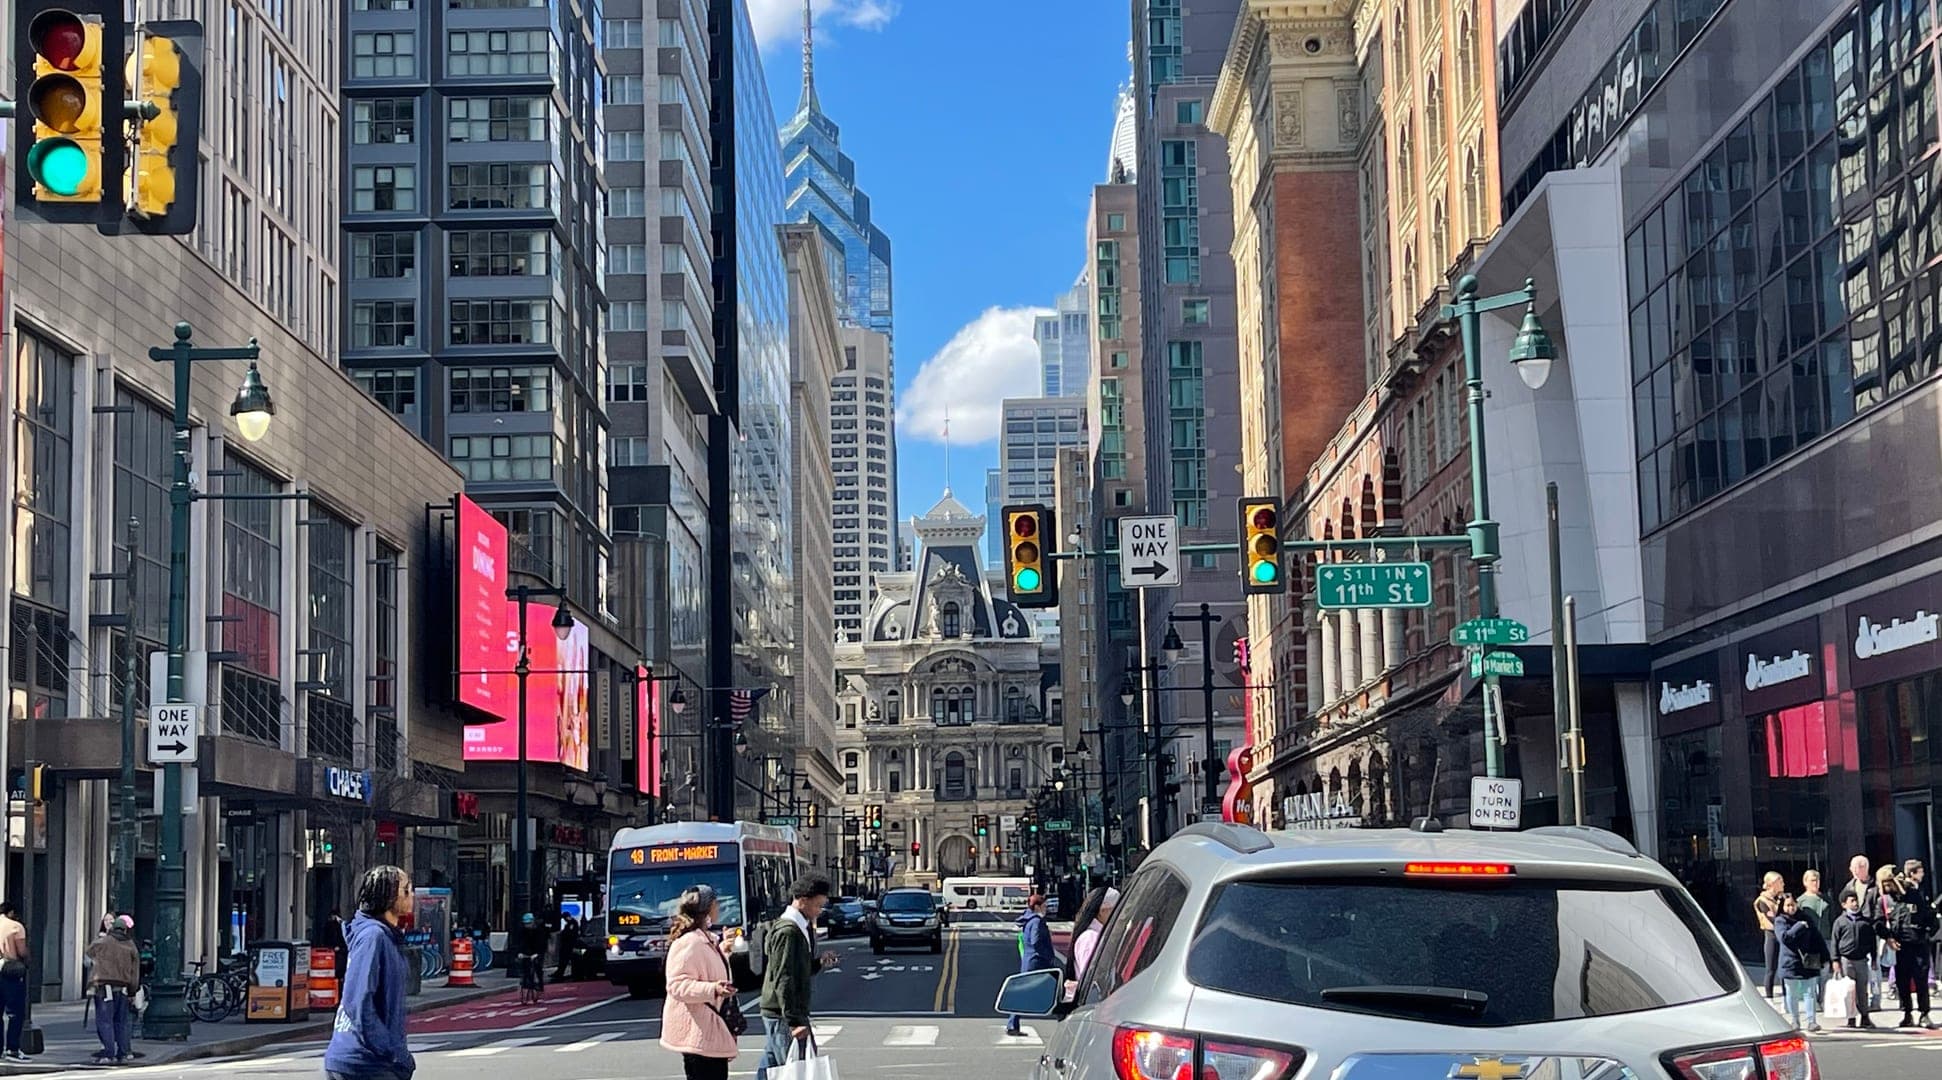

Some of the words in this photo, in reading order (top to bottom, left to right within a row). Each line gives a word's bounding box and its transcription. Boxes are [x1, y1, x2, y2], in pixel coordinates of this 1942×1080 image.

[1131, 523, 1167, 539] ONE
[1131, 541, 1168, 557] WAY
[1335, 583, 1374, 603] 11th
[1388, 583, 1414, 603] St
[1474, 628, 1497, 641] 11th
[1509, 628, 1526, 641] St
[158, 709, 189, 722] ONE
[158, 724, 189, 736] WAY
[330, 766, 362, 800] CHASE
[1489, 783, 1504, 794] NO
[1481, 796, 1512, 807] TURN
[1475, 809, 1490, 818] ON
[1494, 809, 1517, 820] RED
[651, 846, 719, 862] FRONT-MARKET
